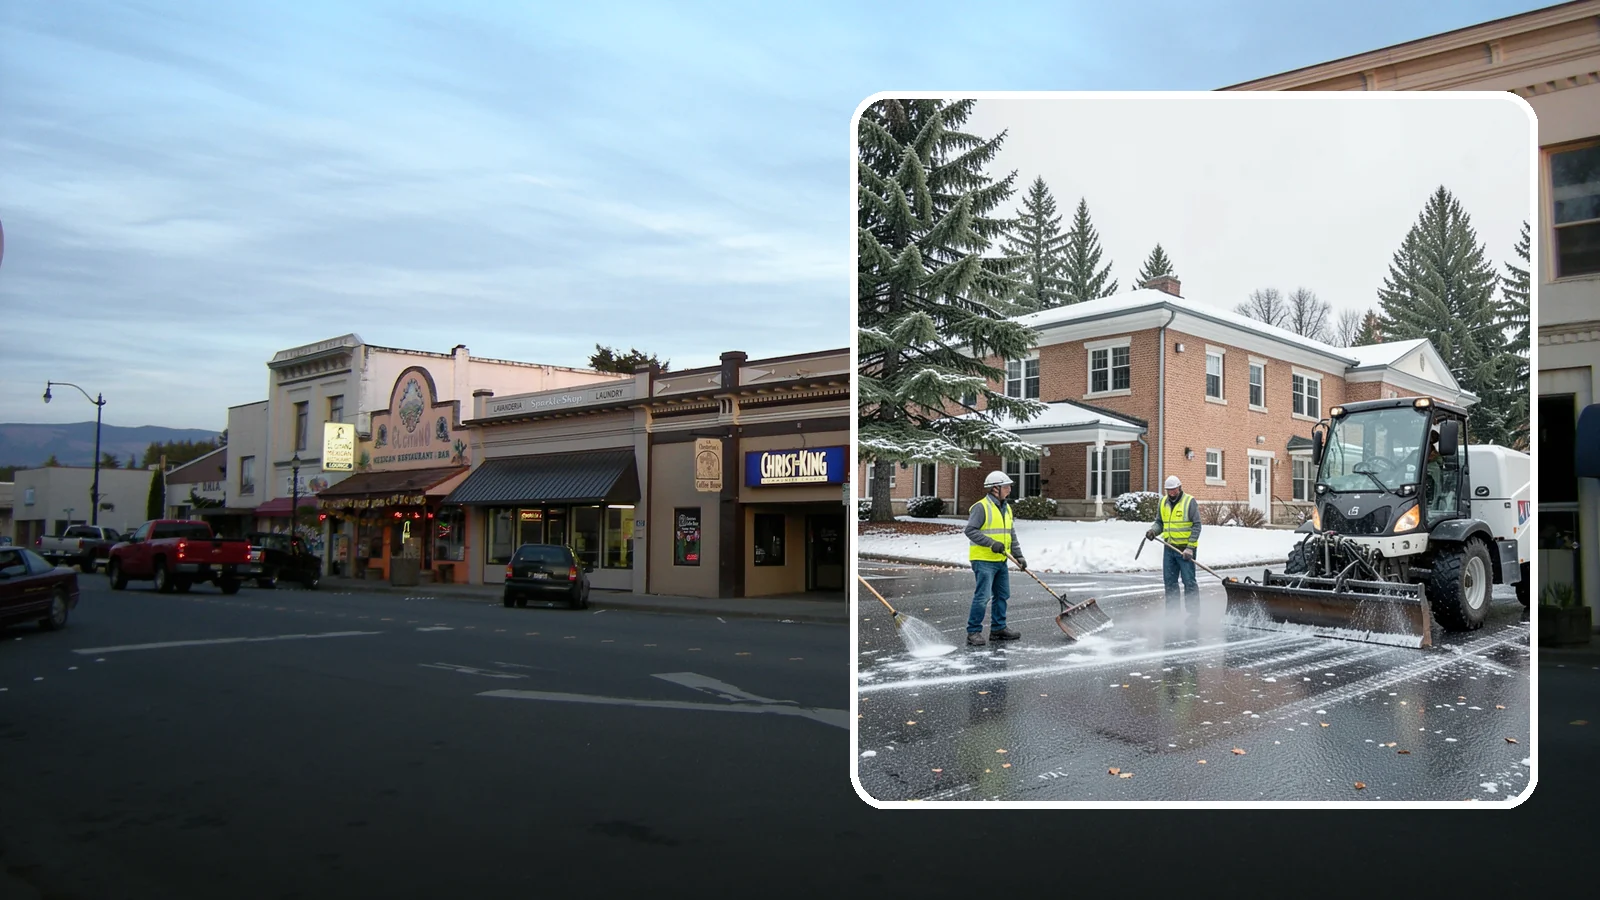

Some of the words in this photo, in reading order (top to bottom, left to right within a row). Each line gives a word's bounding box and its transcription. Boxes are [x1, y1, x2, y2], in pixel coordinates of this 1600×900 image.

[531, 399, 561, 409] Sparkle
[562, 394, 583, 406] Shop
[595, 389, 624, 400] LAUNDRY
[493, 402, 523, 413] LAVANDERIA
[373, 455, 396, 465] MEXICAN
[397, 451, 434, 463] RESTAURANT
[438, 450, 450, 459] BAR
[760, 451, 798, 479] CHRIST
[799, 450, 828, 477] KING
